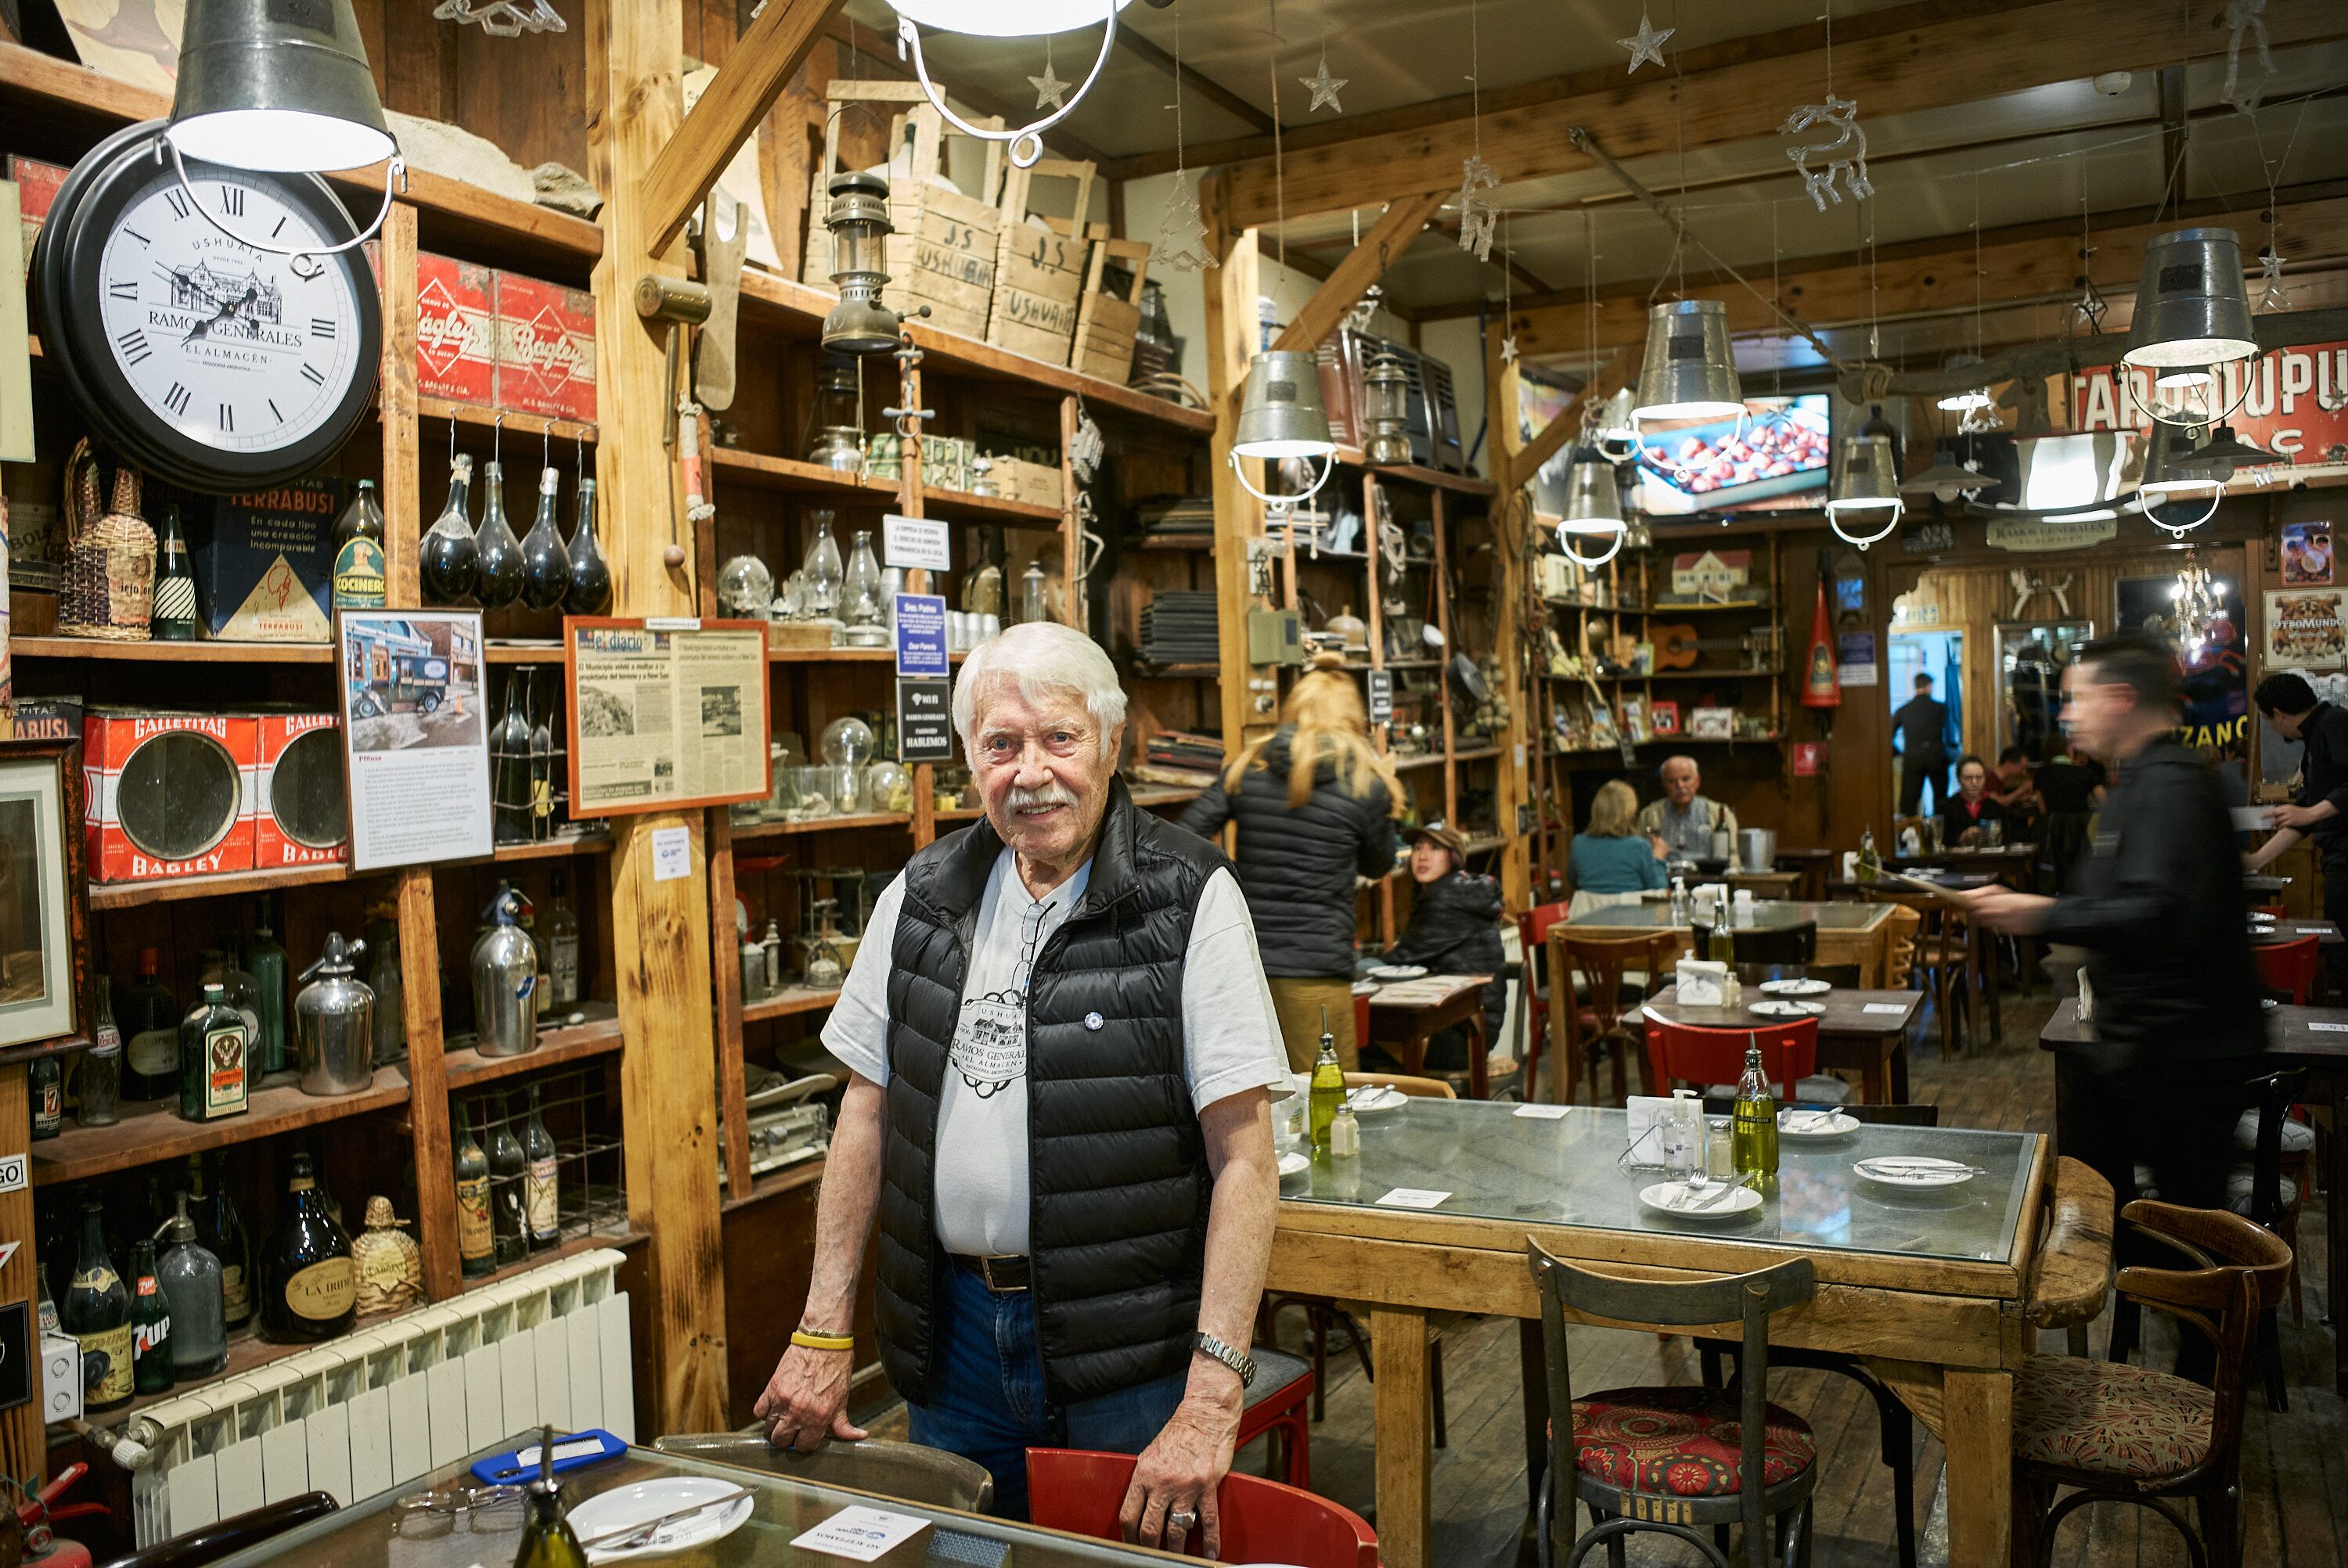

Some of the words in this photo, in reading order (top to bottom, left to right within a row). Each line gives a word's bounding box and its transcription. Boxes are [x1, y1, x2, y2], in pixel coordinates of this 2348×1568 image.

[220, 185, 244, 218] XII
[149, 311, 200, 332] RAMO
[211, 321, 303, 349] GENERALES
[416, 302, 479, 354] ágley
[250, 515, 263, 526] En
[267, 517, 296, 528] cada
[297, 519, 317, 530] tipo
[250, 529, 269, 538] una
[259, 621, 304, 631] TERRABUSI
[610, 629, 643, 651] diario
[585, 662, 614, 672] Municipio
[578, 672, 608, 682] propietaria
[13, 705, 58, 717] ETITAS
[14, 717, 69, 739] ABUSI
[135, 717, 227, 740] GALLETITAS
[906, 736, 948, 748] HABLEMOS
[132, 849, 224, 878] BAGLEY
[956, 1026, 971, 1035] 1906
[952, 1038, 984, 1057] RAMOS
[965, 1064, 990, 1074] PATAGONIA
[131, 1314, 171, 1361] 7UP
